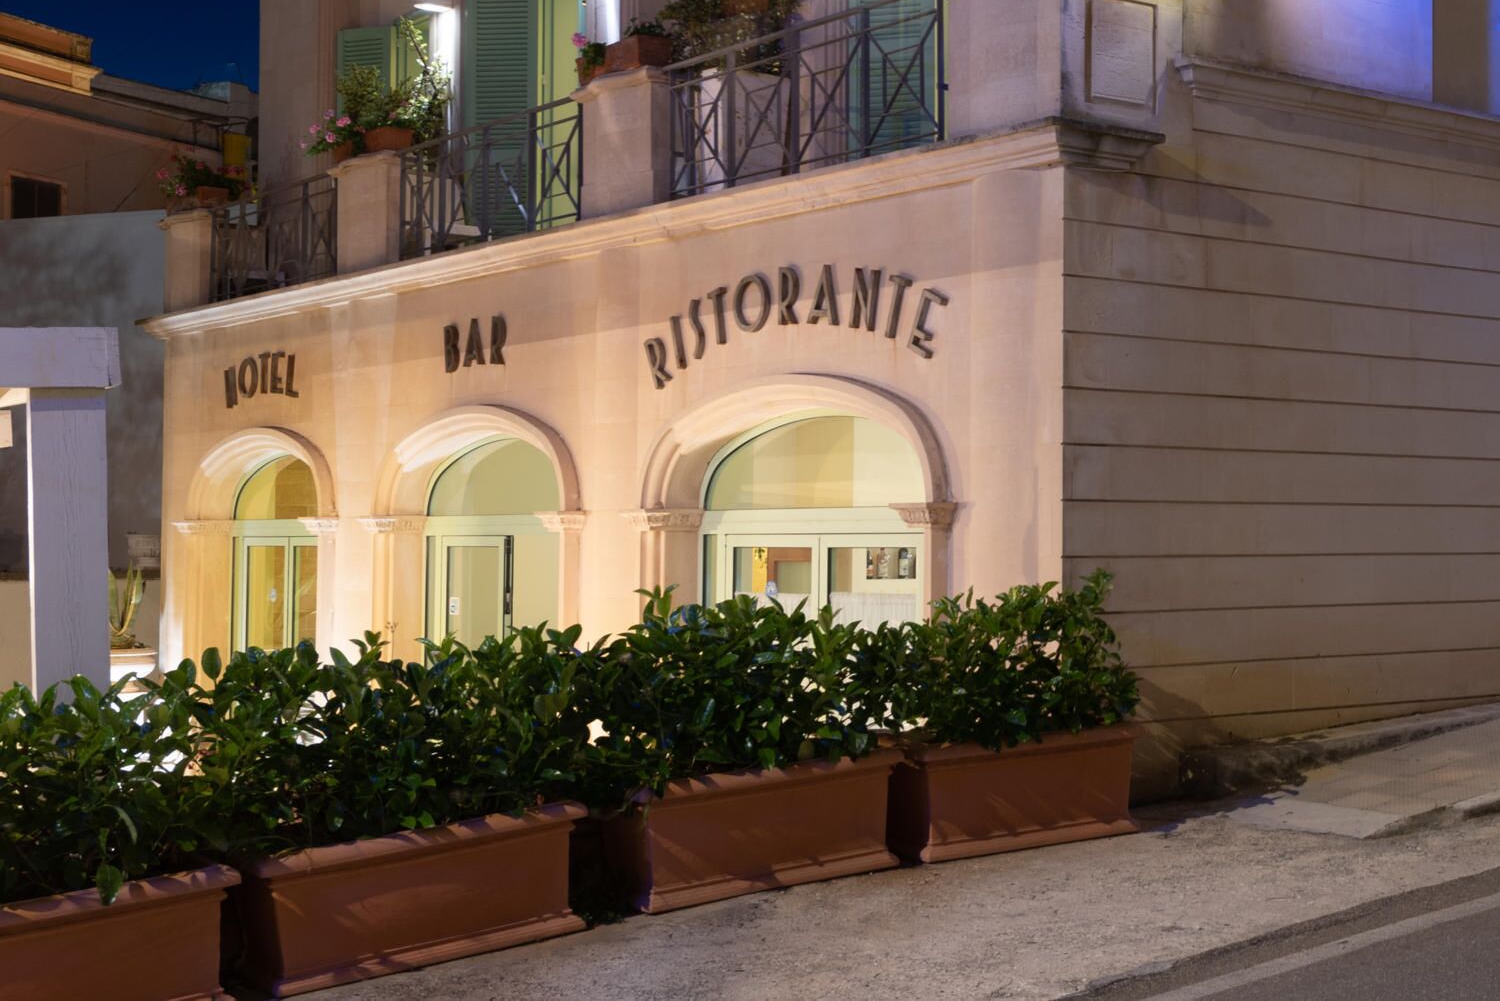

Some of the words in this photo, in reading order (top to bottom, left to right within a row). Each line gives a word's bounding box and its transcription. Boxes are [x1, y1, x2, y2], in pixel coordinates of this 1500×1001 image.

[443, 313, 508, 374] BAR
[643, 263, 950, 390] RISTORANTE
[223, 350, 300, 409] HOTEL
